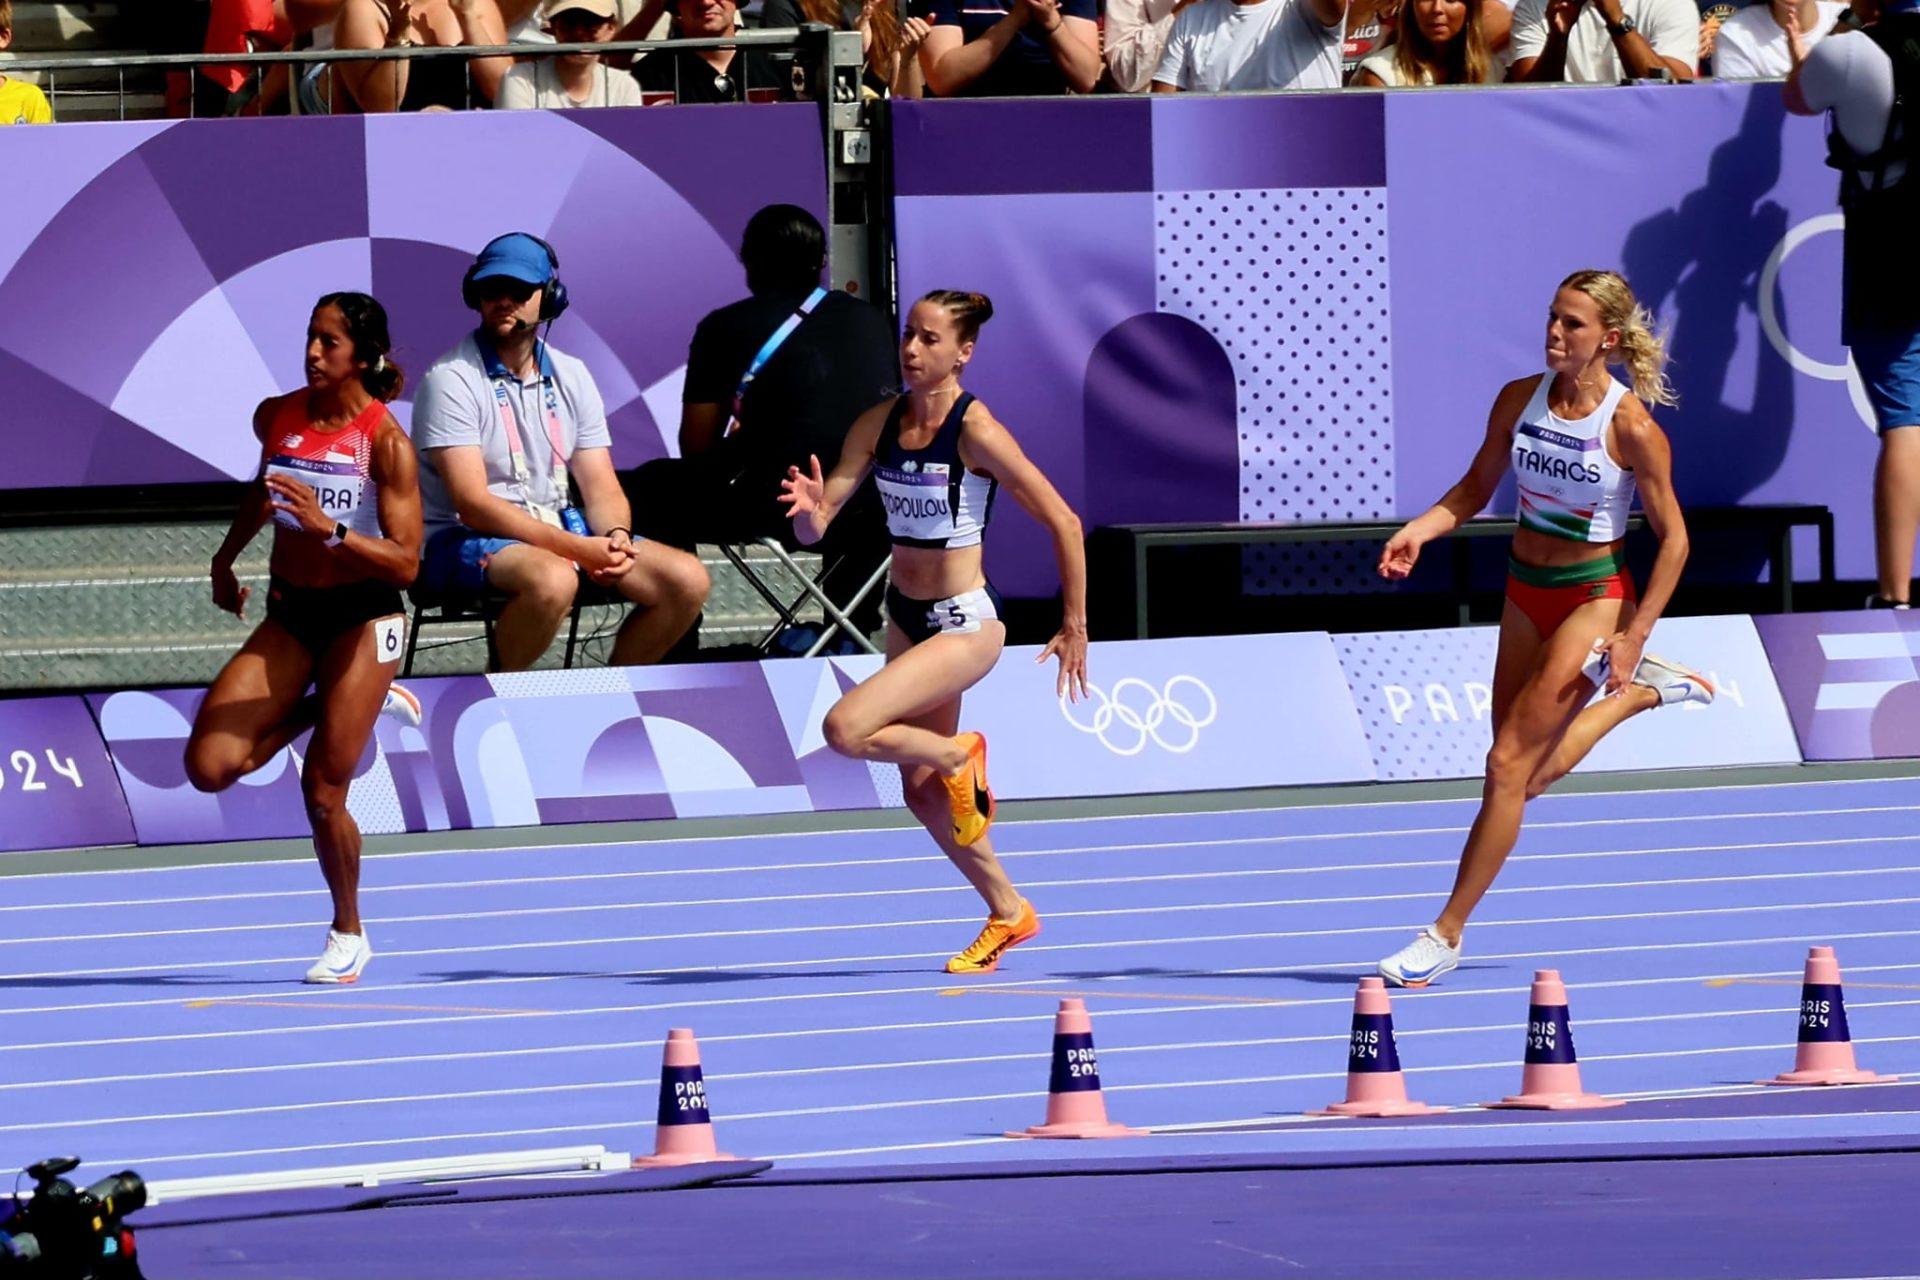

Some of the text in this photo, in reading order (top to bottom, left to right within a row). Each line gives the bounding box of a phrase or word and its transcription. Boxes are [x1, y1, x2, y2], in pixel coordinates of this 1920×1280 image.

[1516, 446, 1601, 484] TAKACS
[948, 605, 967, 627] 5
[386, 628, 397, 653] 6
[0, 749, 84, 791] 24
[1529, 1021, 1556, 1036] RIS
